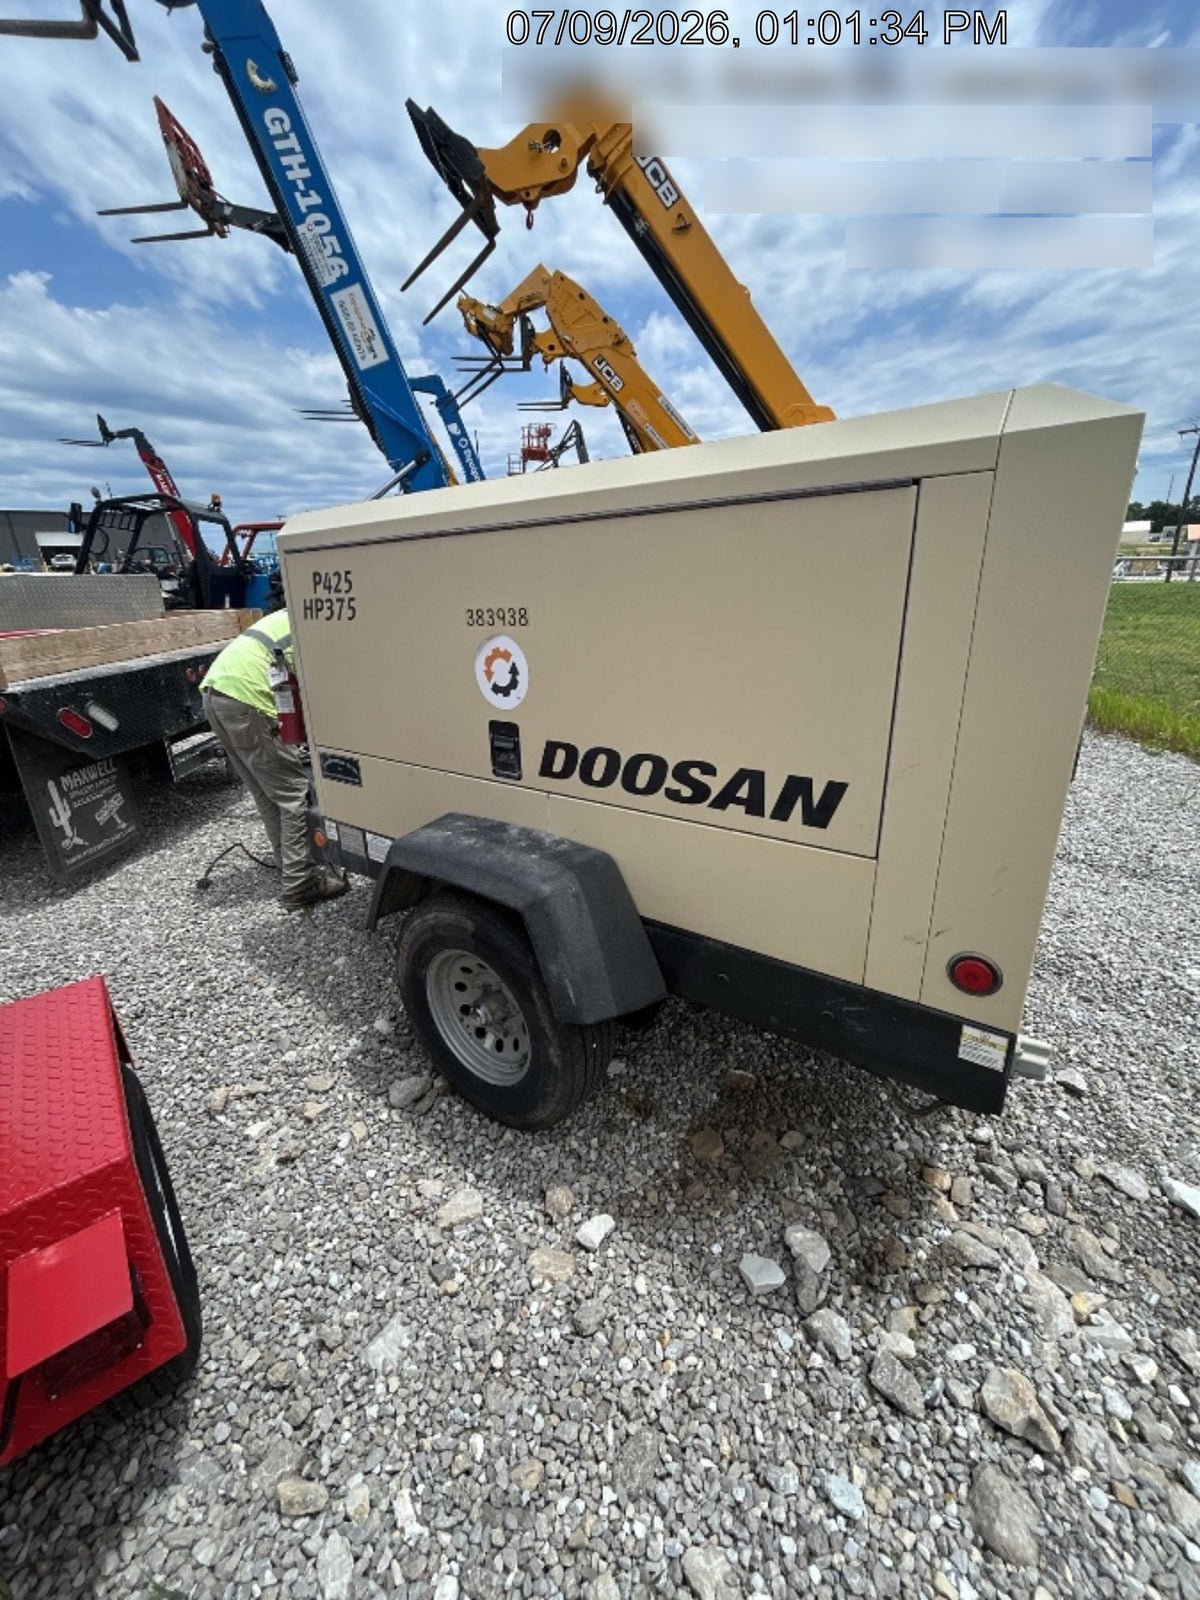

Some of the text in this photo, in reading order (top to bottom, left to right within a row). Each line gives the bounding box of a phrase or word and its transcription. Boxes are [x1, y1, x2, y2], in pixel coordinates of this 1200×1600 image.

[593, 357, 624, 391] JCB
[312, 570, 353, 594] P425
[303, 597, 357, 622] HP375
[466, 607, 529, 627] 383938
[60, 757, 118, 792] MAXWELL
[538, 740, 849, 829] DOOSAN
